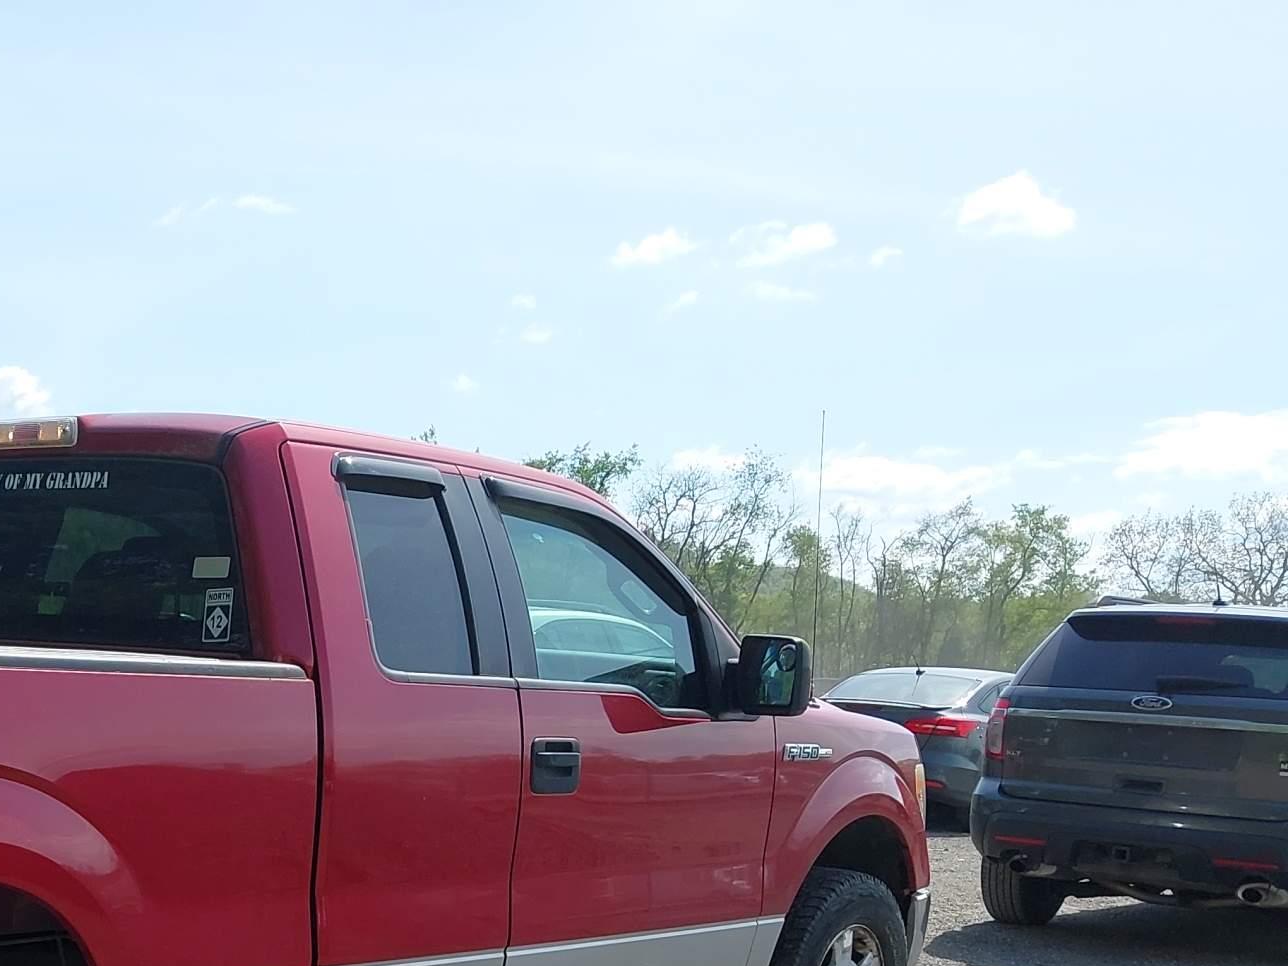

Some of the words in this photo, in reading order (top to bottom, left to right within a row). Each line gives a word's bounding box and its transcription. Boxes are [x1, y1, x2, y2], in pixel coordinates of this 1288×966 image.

[4, 473, 22, 490] OF
[24, 473, 44, 490] MY
[46, 471, 109, 489] GRANDPA
[208, 592, 231, 601] NORTH
[211, 614, 223, 629] 12
